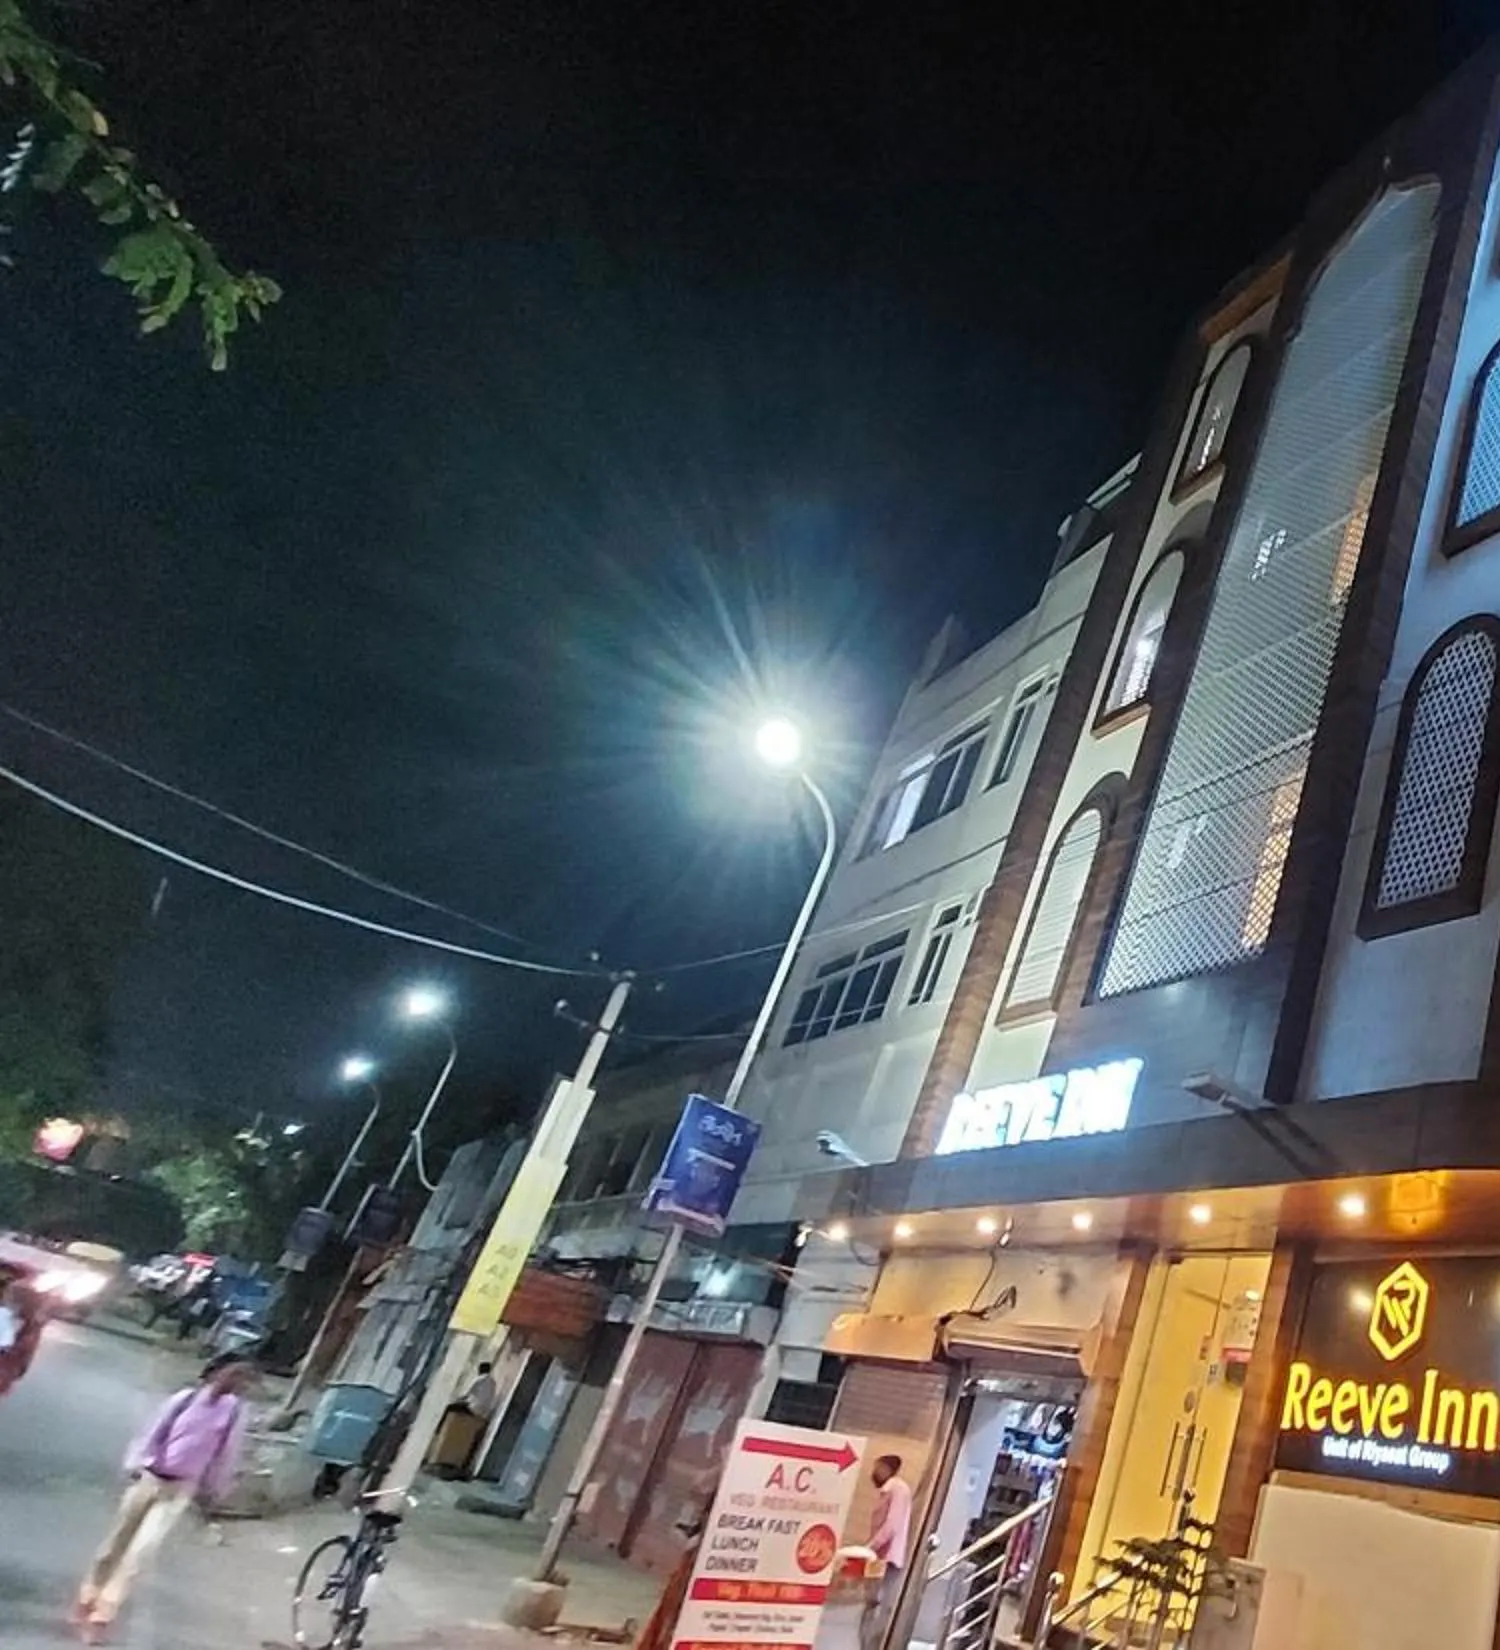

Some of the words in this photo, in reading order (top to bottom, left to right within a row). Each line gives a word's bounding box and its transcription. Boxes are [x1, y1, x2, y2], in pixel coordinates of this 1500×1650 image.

[1280, 1361, 1409, 1439] Reeve
[1416, 1368, 1500, 1452] Inn
[765, 1463, 817, 1493] A.C.
[717, 1513, 767, 1532] BREAK
[767, 1517, 802, 1536] FAST
[711, 1534, 761, 1552] LUNCH
[704, 1555, 760, 1574] DINNER
